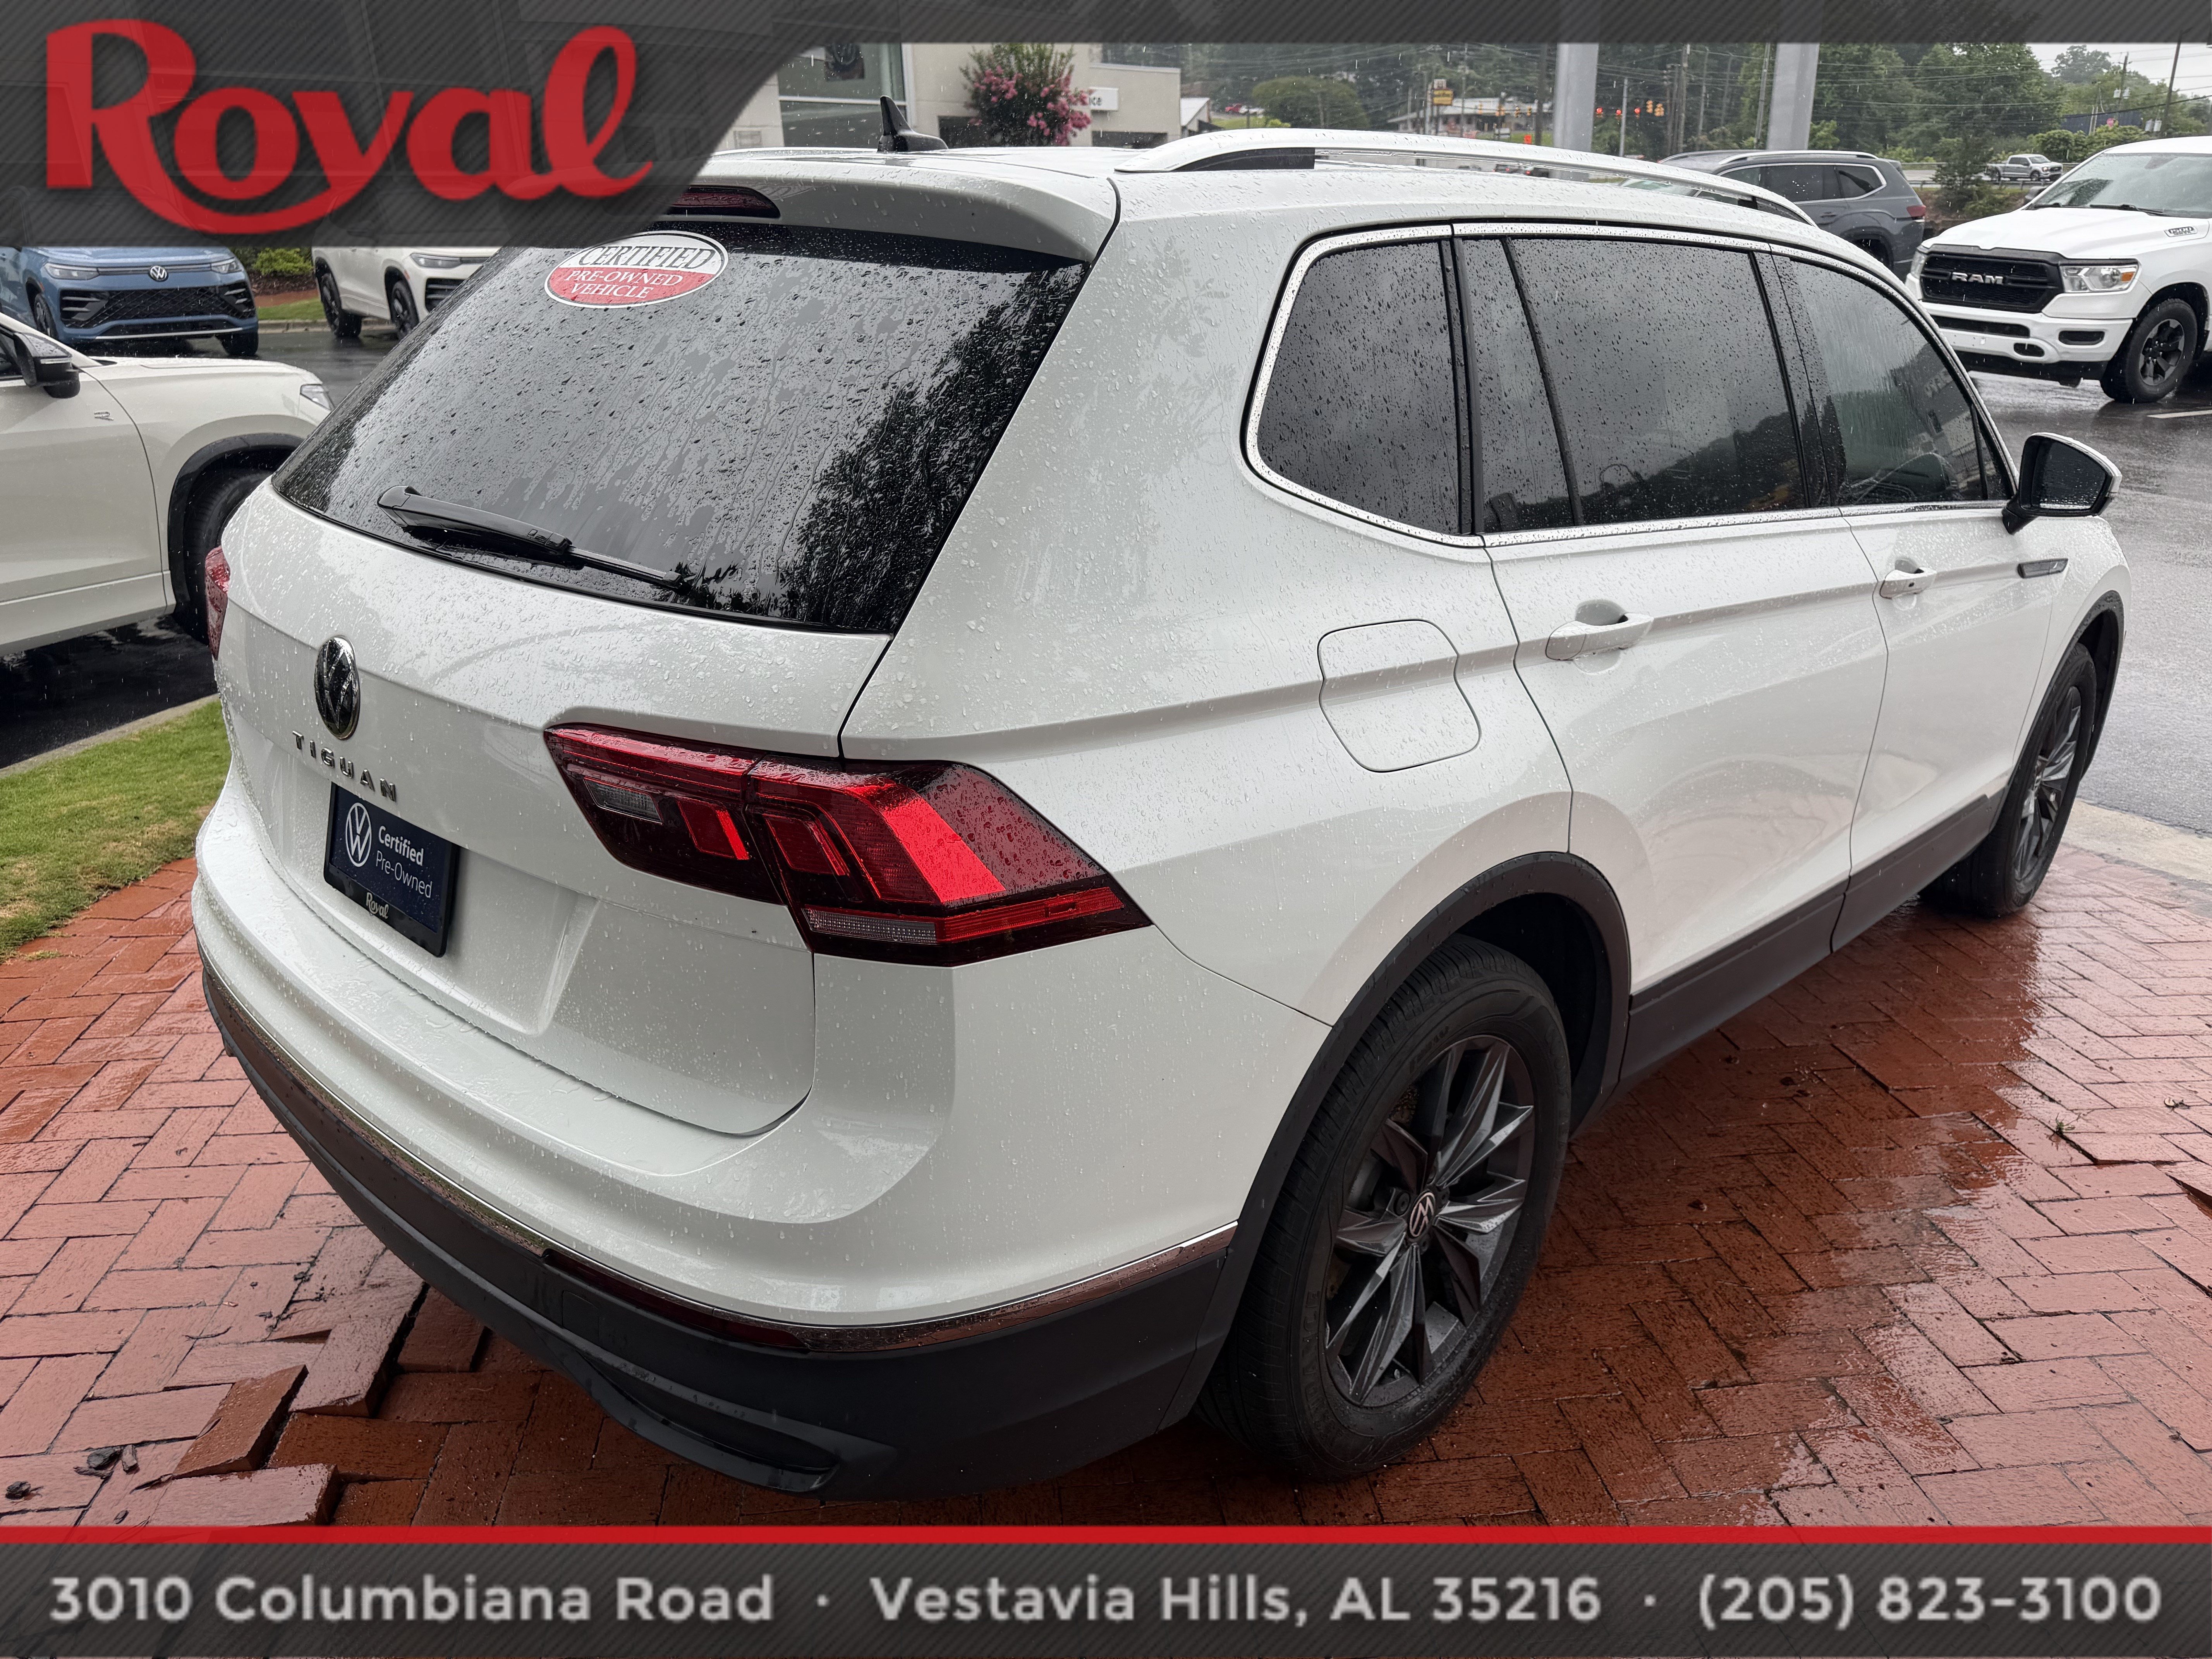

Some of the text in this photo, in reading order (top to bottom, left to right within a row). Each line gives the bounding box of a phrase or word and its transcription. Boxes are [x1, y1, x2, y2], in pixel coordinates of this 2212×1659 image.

[579, 246, 716, 268] CERTIFIED
[564, 270, 683, 286] PRE-OWNED
[1951, 272, 2004, 285] RAM
[570, 283, 655, 299] VEHICLE
[292, 730, 397, 802] TIGUAN
[378, 825, 424, 867] Certified
[376, 850, 433, 899] Pre-Owned
[365, 891, 389, 920] Royal
